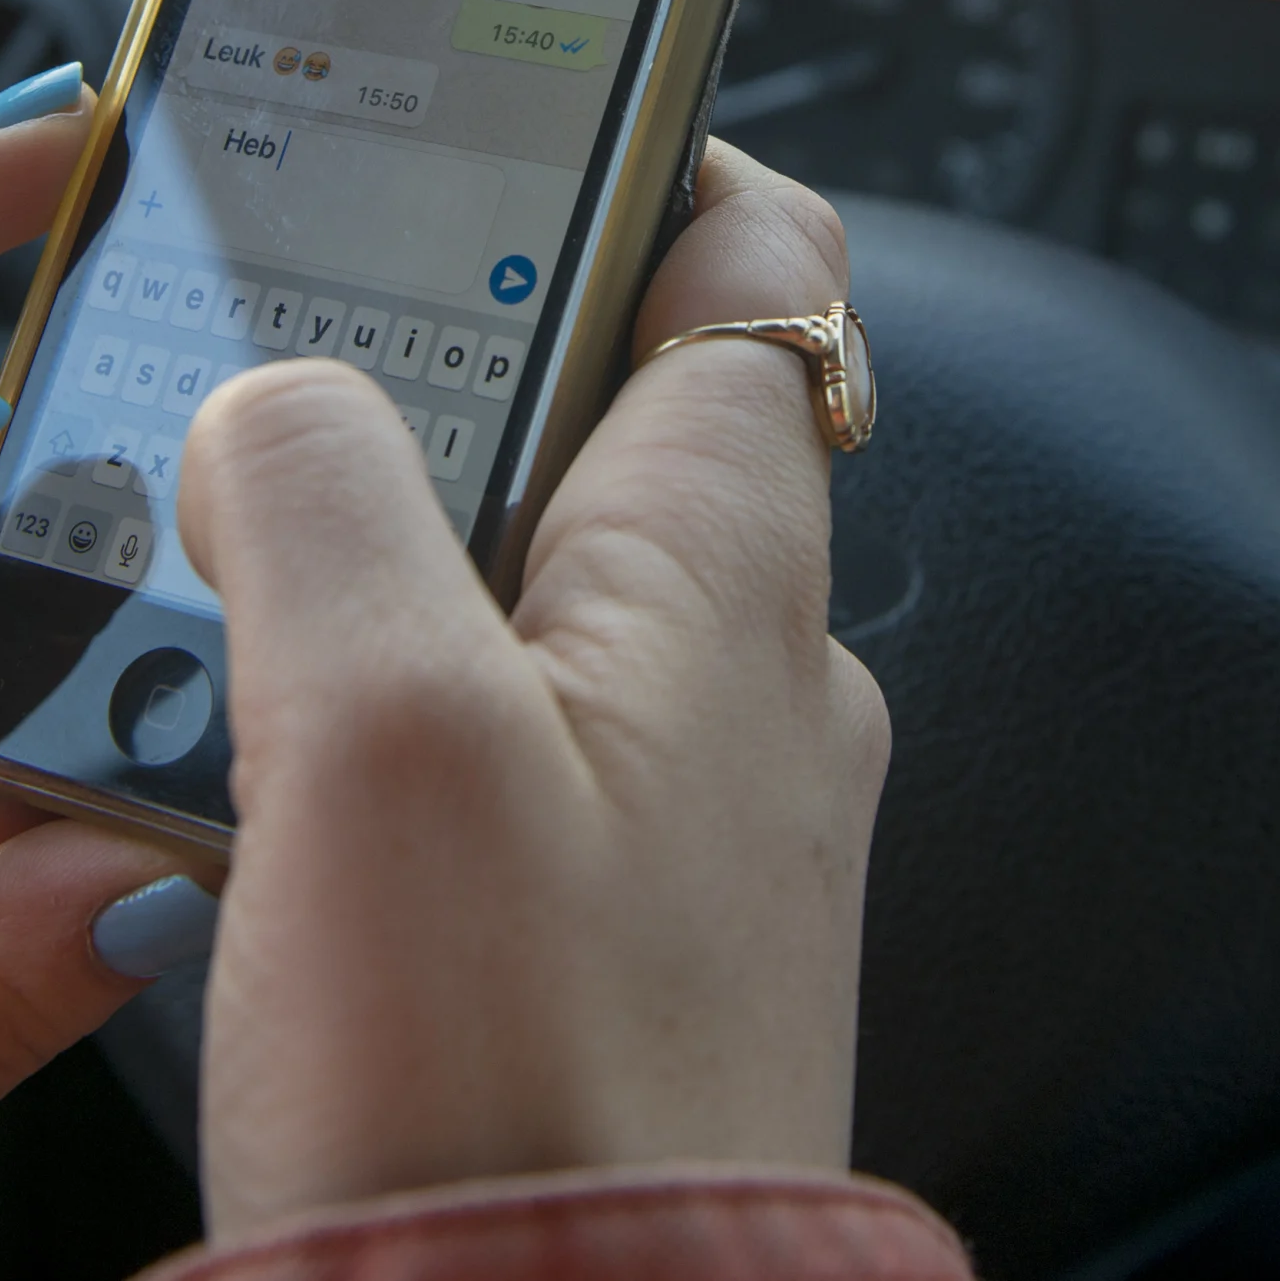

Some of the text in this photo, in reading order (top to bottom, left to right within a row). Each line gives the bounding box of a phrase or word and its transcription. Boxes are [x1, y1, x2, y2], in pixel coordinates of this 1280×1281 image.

[203, 36, 266, 68] Leuk
[492, 23, 555, 51] 15:40
[357, 86, 419, 114] 15:50
[223, 128, 276, 160] Heb
[102, 270, 510, 383] q w e r t y u i o p
[94, 354, 115, 376] a
[136, 363, 156, 385] s
[176, 368, 201, 396] d
[107, 444, 170, 478] z x
[14, 512, 50, 538] 123
